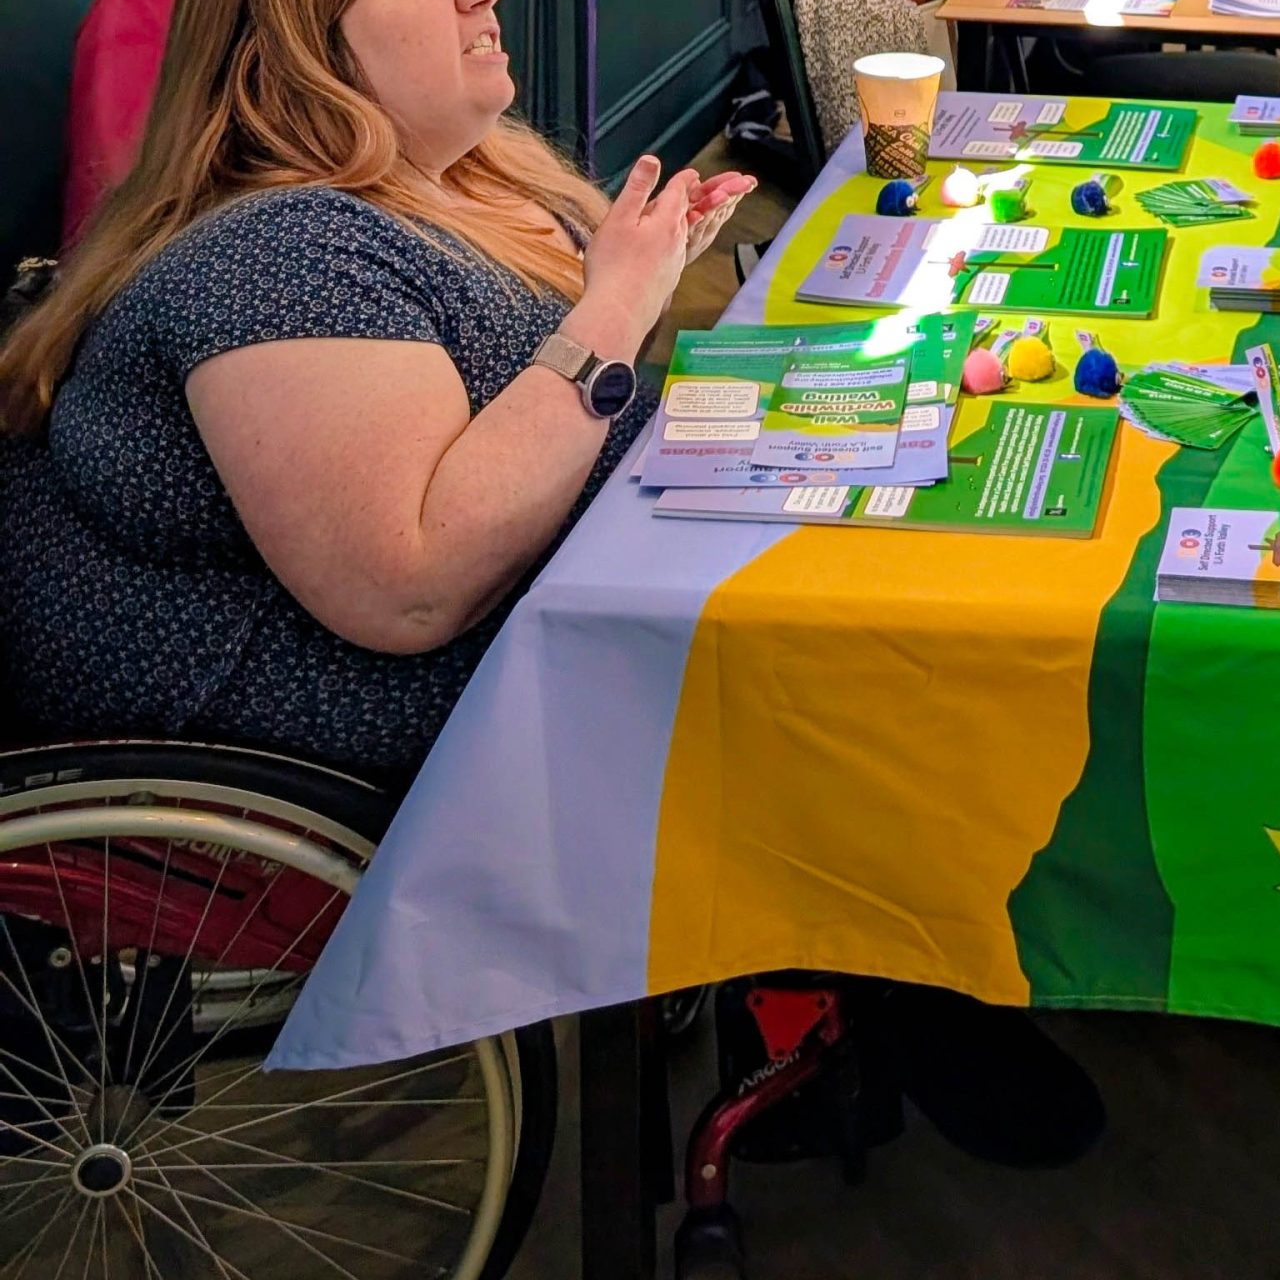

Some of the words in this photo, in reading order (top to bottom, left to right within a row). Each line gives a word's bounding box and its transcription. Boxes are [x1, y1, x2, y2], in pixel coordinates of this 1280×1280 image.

[804, 391, 878, 401] Waiting
[781, 401, 894, 414] Worthwhile
[812, 414, 859, 424] Well
[1203, 514, 1217, 537] Support
[1217, 523, 1231, 541] Valley
[1200, 537, 1213, 560] Directed
[1214, 541, 1226, 555] Forth
[1197, 555, 1209, 572] Self
